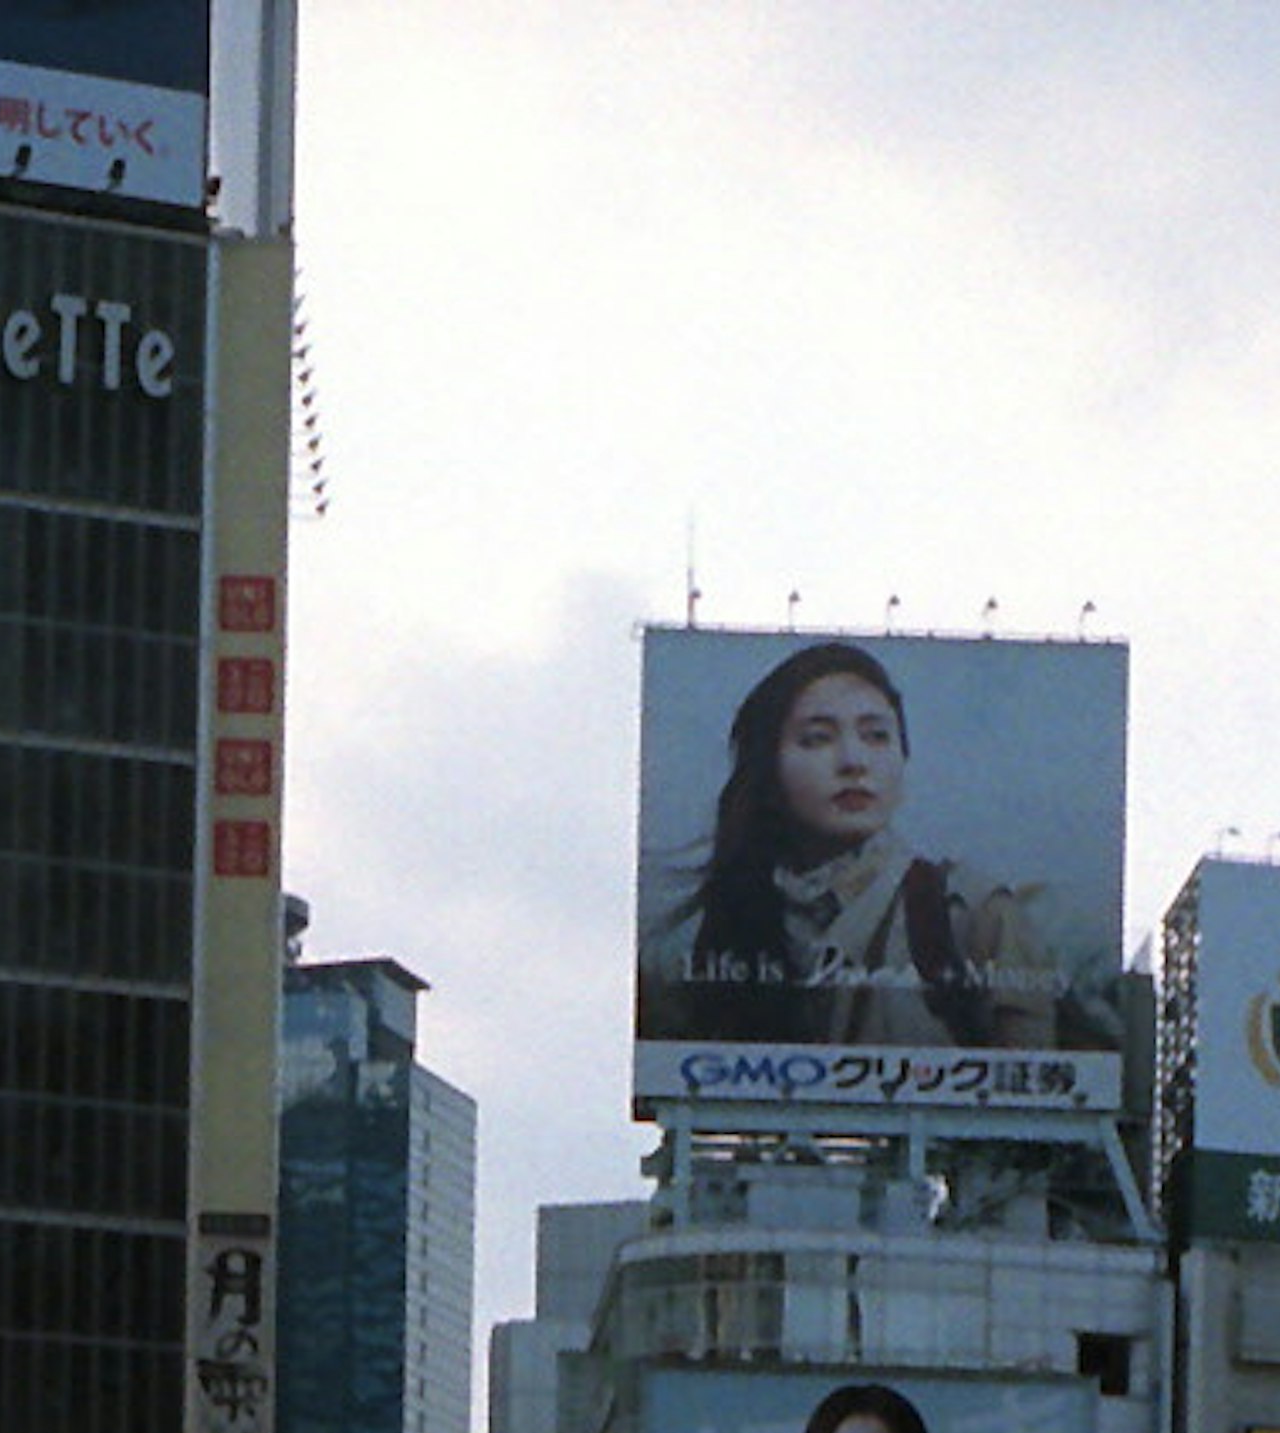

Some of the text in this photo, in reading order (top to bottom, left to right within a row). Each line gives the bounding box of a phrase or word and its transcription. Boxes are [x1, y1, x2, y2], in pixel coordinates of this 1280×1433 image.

[680, 1053, 1077, 1095] GMOクリック証券
